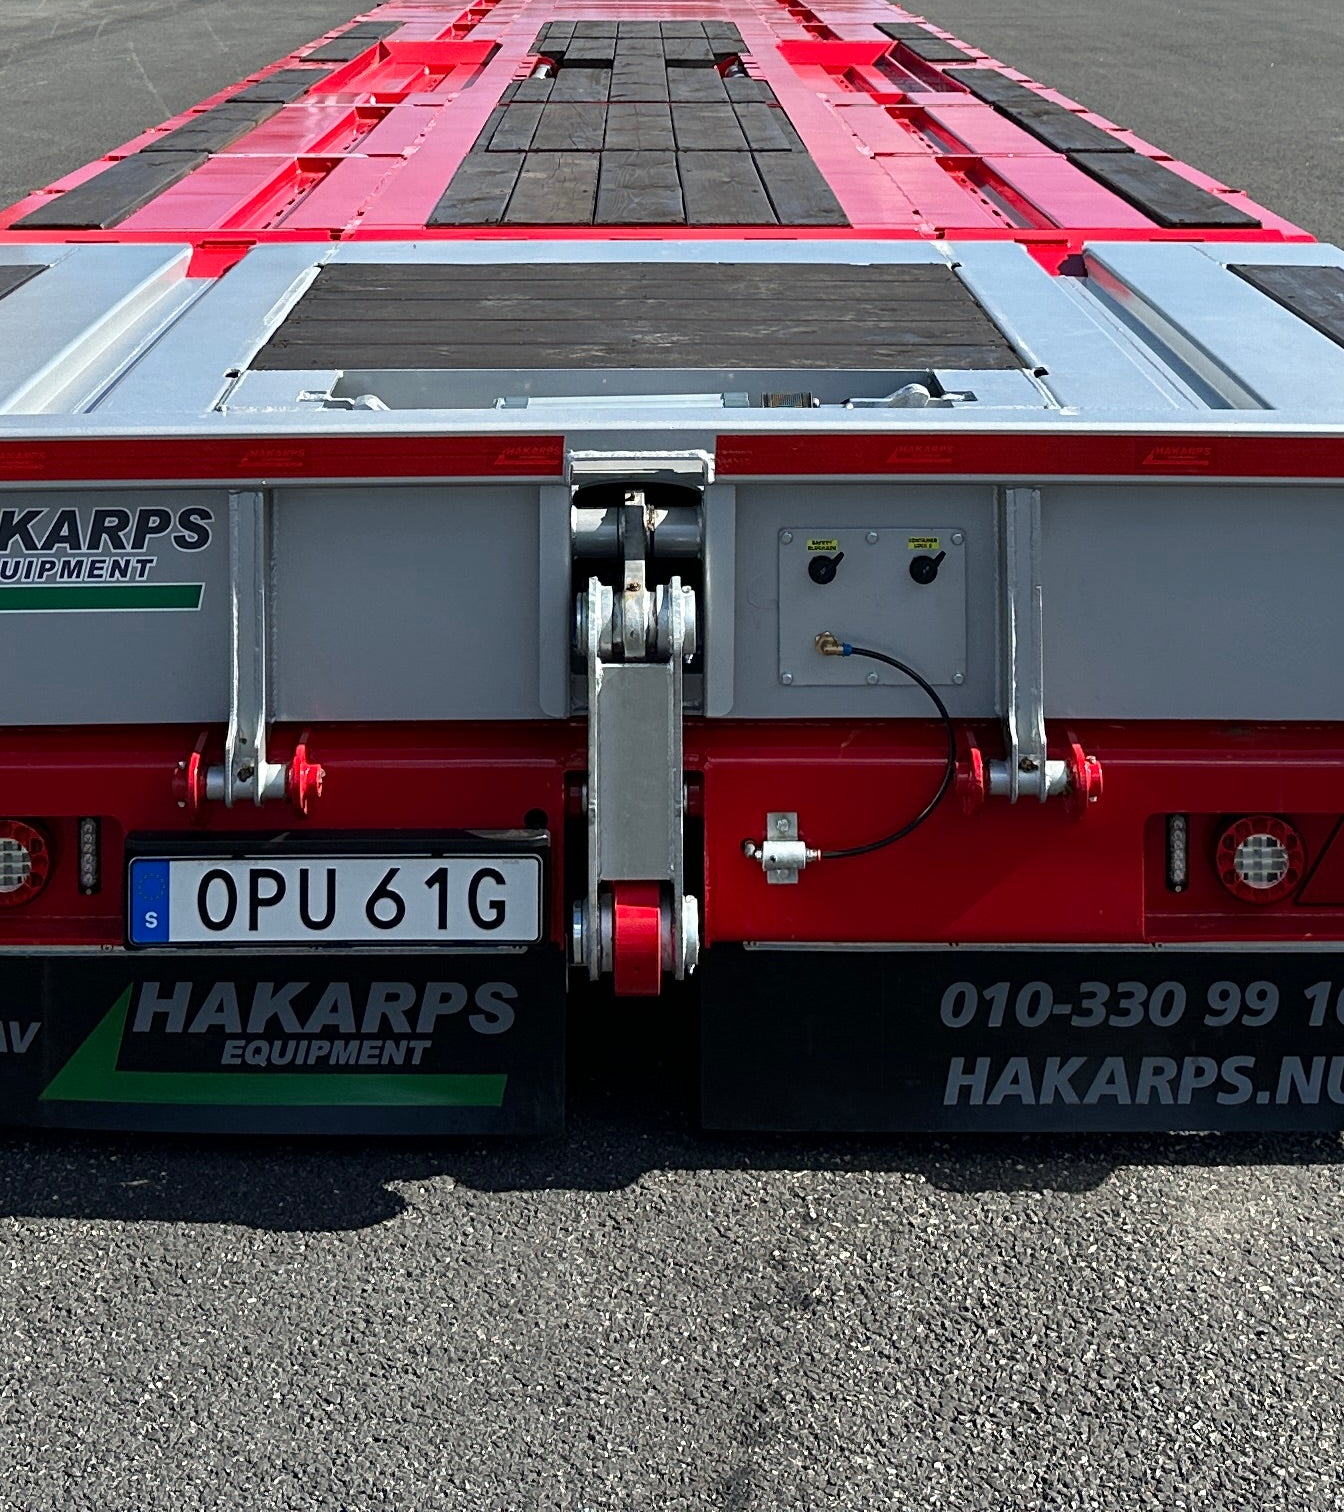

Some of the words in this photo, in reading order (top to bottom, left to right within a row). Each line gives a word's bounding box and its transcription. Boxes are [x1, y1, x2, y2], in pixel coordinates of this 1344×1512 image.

[145, 911, 158, 929] S
[197, 868, 337, 931] OPU
[365, 867, 507, 931] 61G
[132, 982, 519, 1035] HAKARPS
[940, 981, 1187, 1028] 010-330
[1203, 980, 1280, 1027] 99
[221, 1040, 432, 1067] EQUIPMENT
